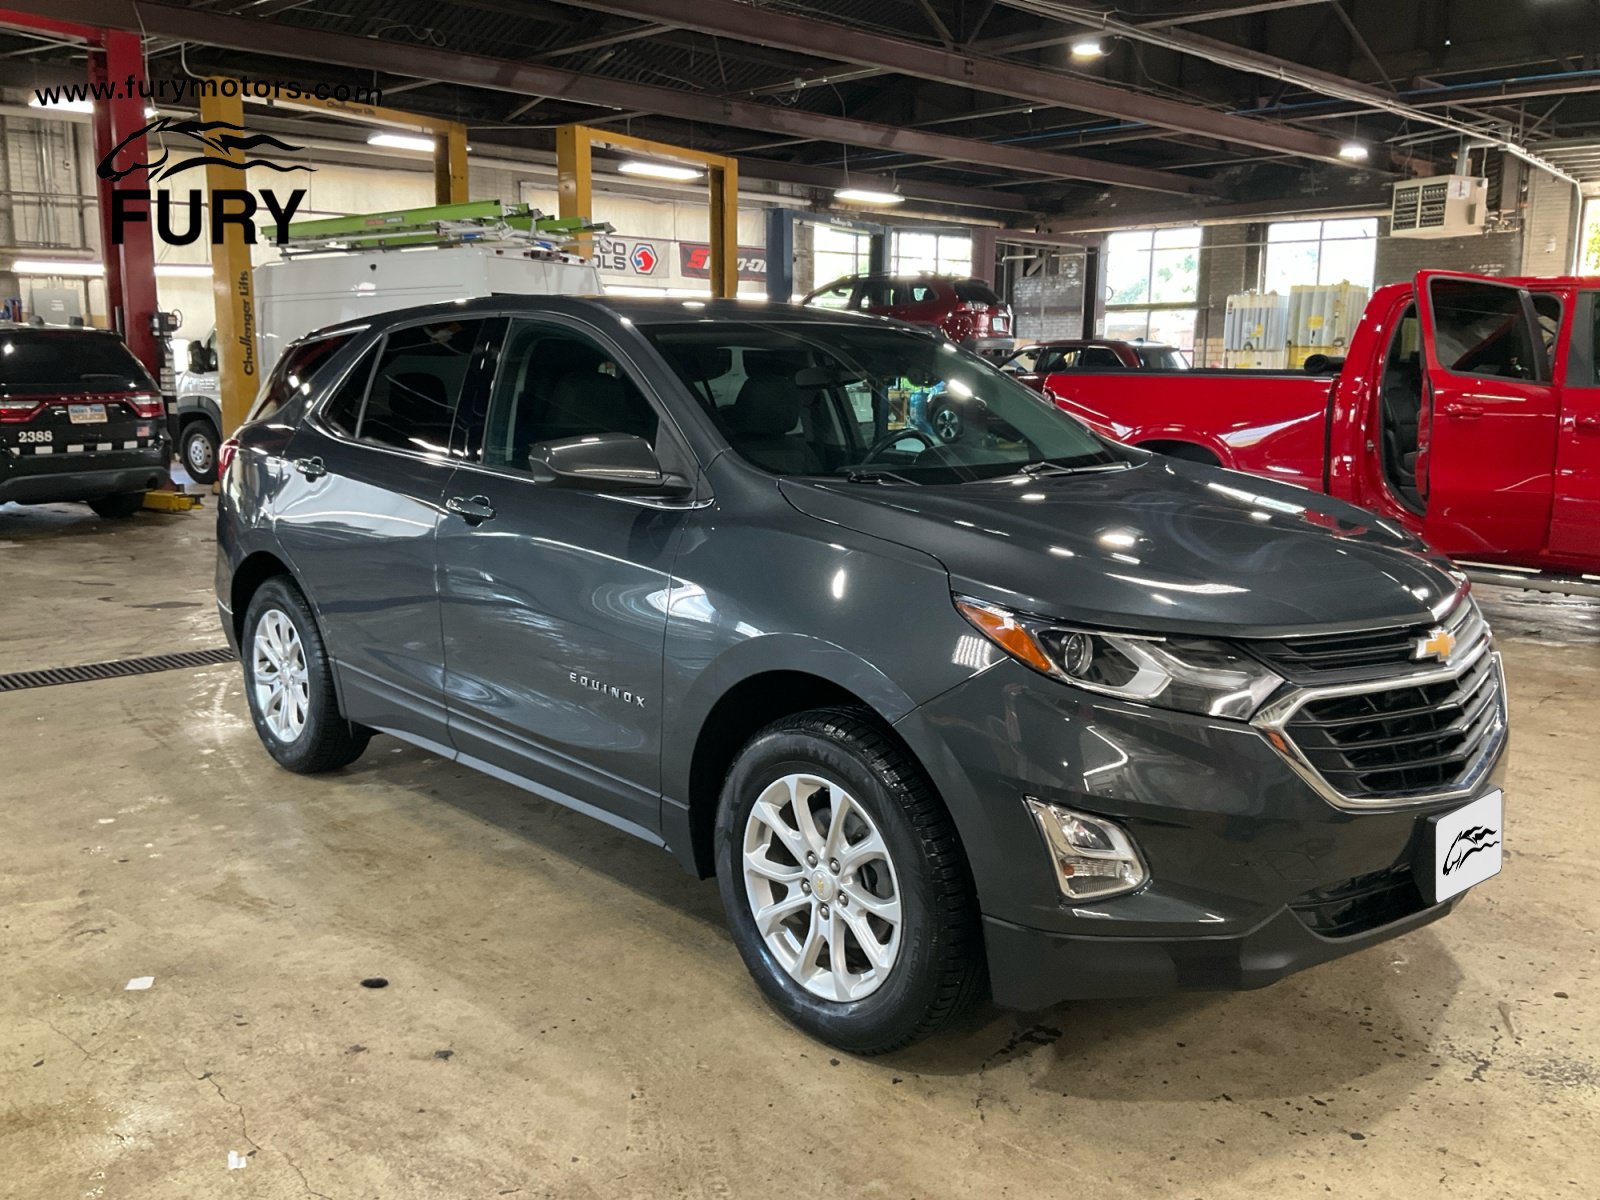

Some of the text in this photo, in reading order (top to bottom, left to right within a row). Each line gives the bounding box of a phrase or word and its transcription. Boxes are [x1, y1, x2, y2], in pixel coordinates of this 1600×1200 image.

[238, 270, 254, 376] Challenger Lifts
[18, 430, 53, 443] 2388
[569, 671, 646, 708] EQUINOX
